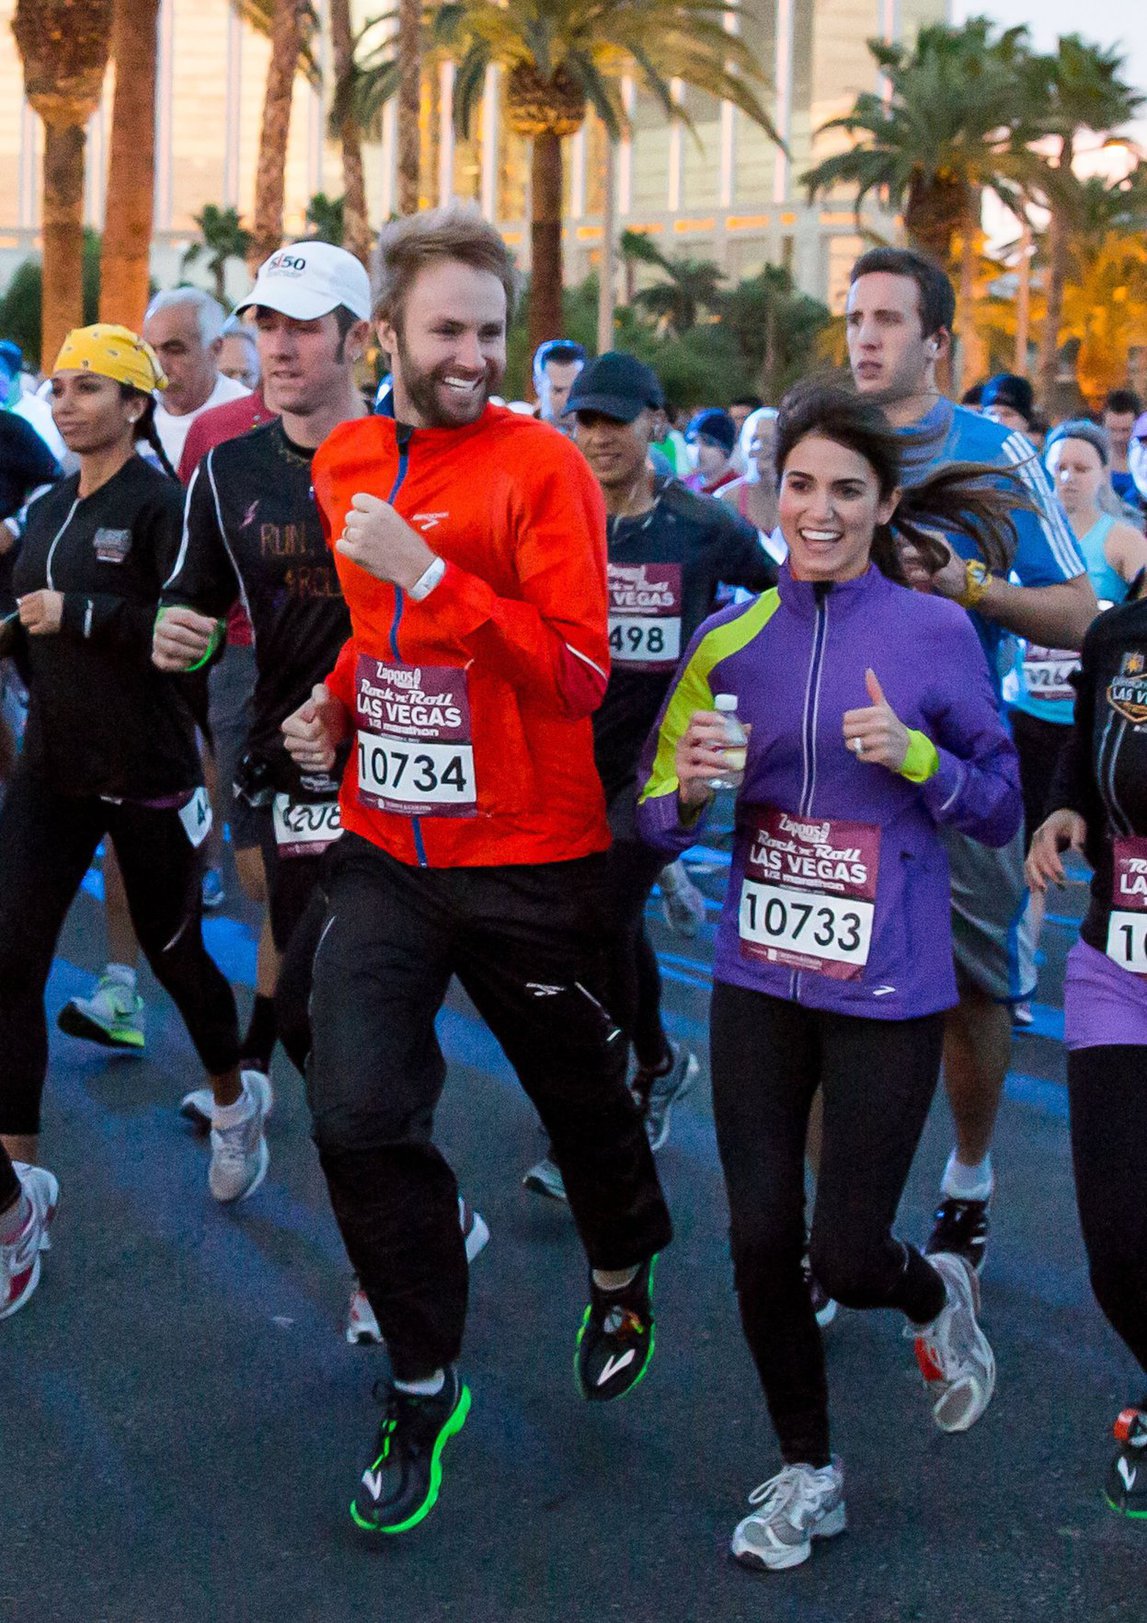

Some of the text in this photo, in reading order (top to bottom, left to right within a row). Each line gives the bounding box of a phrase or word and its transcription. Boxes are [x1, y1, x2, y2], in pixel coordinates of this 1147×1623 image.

[613, 591, 675, 606] VEGAS
[609, 624, 664, 654] 498
[361, 678, 394, 701] Rock
[408, 690, 454, 706] Roll
[1112, 686, 1134, 701] LAS
[357, 693, 462, 728] LAS VEGAS
[358, 742, 467, 793] 10734
[757, 829, 798, 854] Rock
[813, 843, 862, 863] Roll
[750, 844, 868, 885] LAS VEGAS
[745, 892, 861, 952] 10733
[1119, 924, 1147, 962] 1
